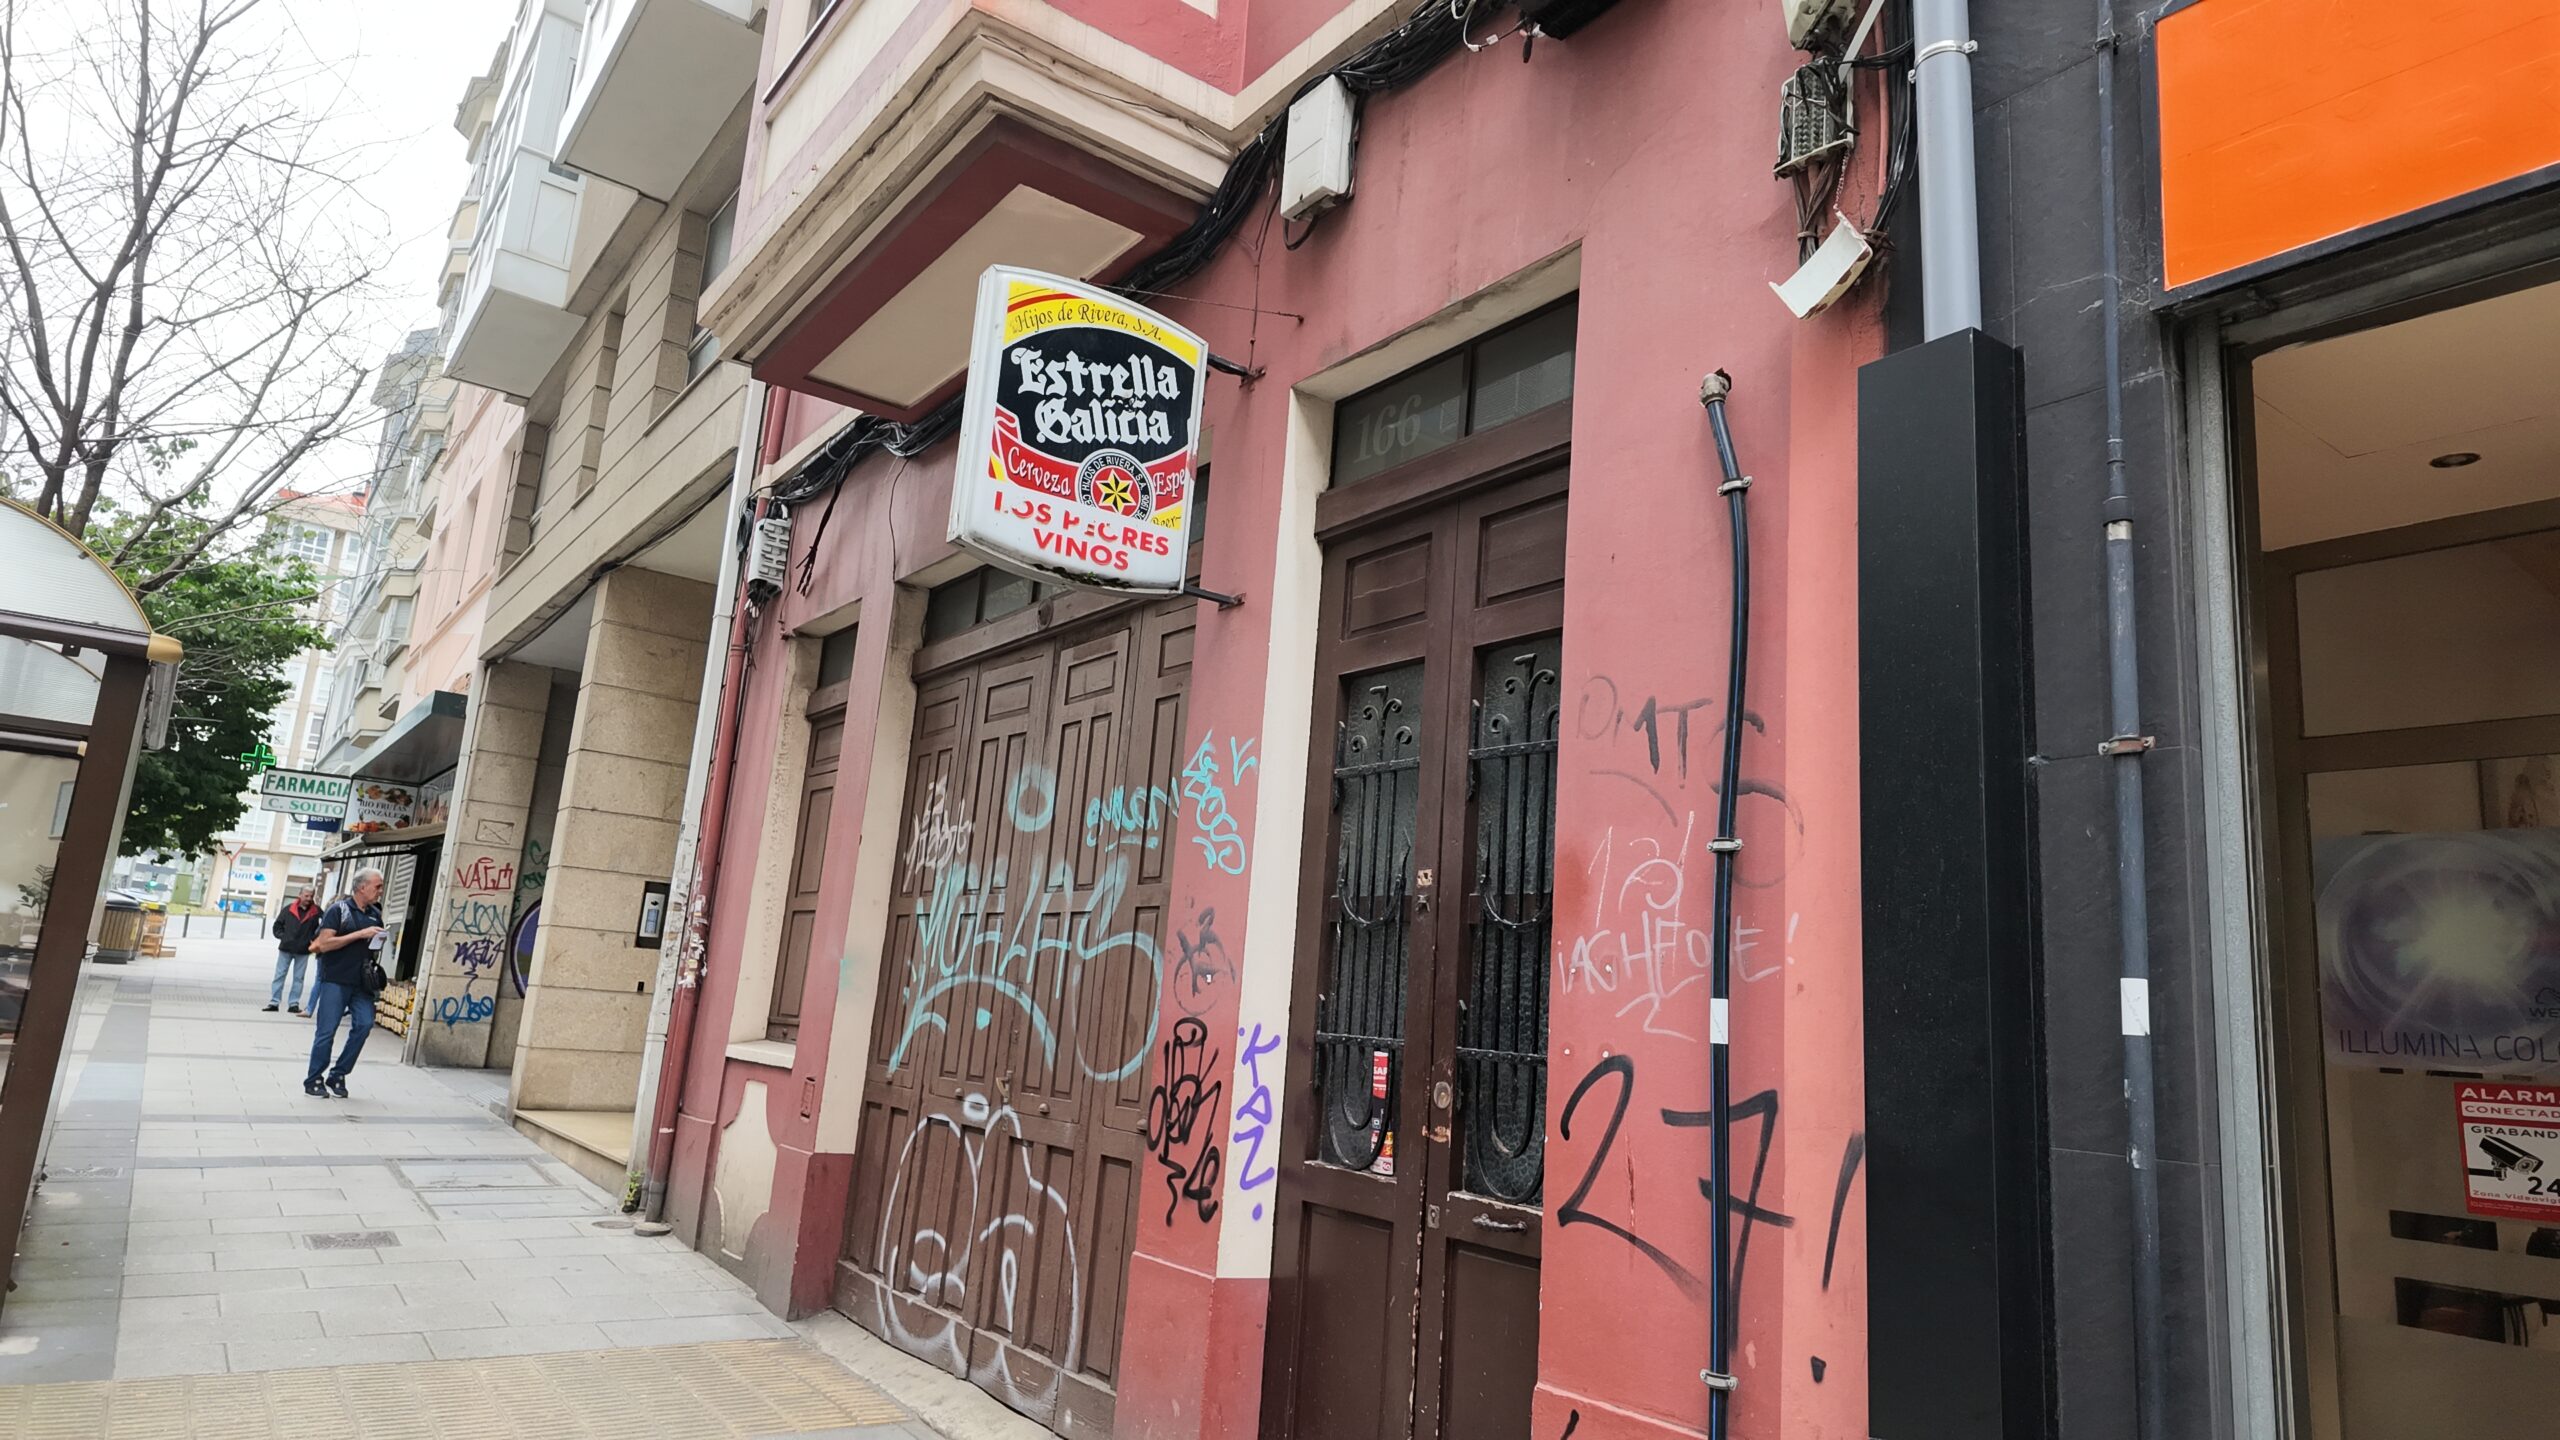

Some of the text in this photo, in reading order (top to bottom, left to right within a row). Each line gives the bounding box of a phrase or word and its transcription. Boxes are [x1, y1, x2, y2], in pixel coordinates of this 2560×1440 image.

[1013, 309, 1054, 332] Hijos
[1058, 301, 1072, 321] de
[1078, 304, 1128, 328] Rivera,
[1011, 346, 1180, 400] Estrella
[1035, 398, 1173, 445] Galicia
[1354, 394, 1422, 464] 166
[1008, 446, 1071, 495] Cerveza
[1082, 467, 1096, 491] HIJOS
[1094, 458, 1106, 470] DE
[1033, 527, 1129, 571] VINOS
[265, 774, 350, 798] FARMACIA
[268, 798, 344, 817] C. SOUTO
[2340, 1029, 2560, 1063] ILLUMINA COL
[2461, 1088, 2560, 1104] ALARM
[2465, 1105, 2560, 1118] CONECTAD
[2473, 1190, 2560, 1204] Zona Videovig
